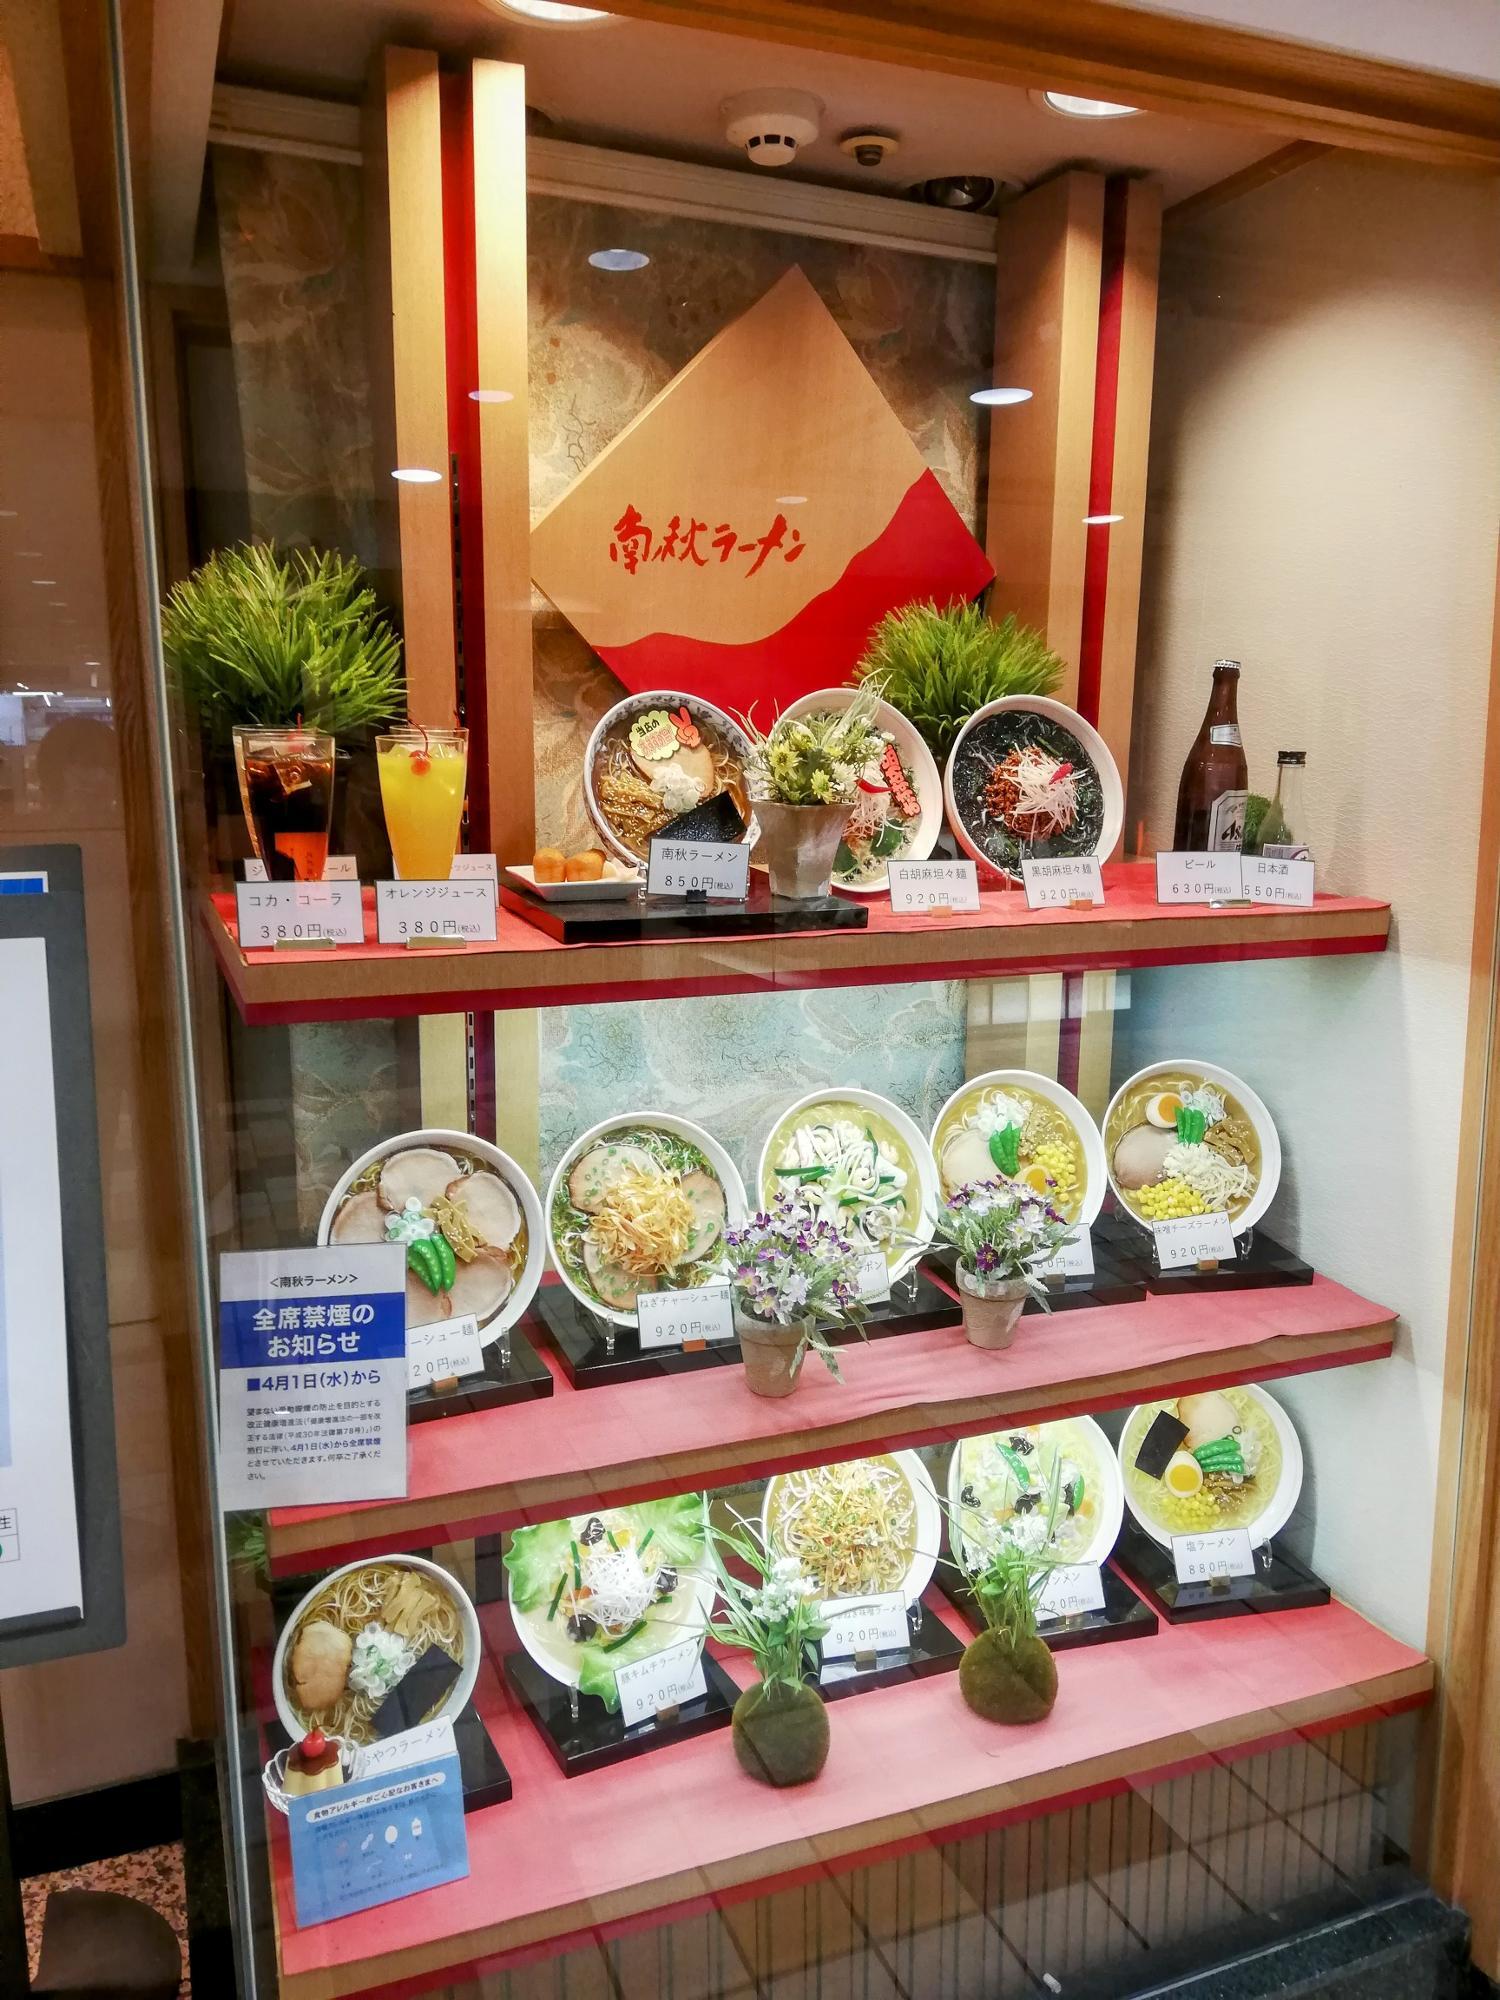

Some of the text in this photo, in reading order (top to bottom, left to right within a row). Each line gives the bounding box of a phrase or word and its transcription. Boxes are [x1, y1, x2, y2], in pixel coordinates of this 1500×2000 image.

[609, 504, 807, 578] 南秋ラーメン
[661, 847, 738, 863] 南秋ラーメン
[1185, 859, 1216, 869] ビール
[1258, 862, 1289, 875] 日本酒
[385, 886, 488, 899] オレンジジュース
[252, 1304, 375, 1331] 全席禁煙の
[267, 1331, 361, 1358] お知らせ
[1186, 1536, 1236, 1552] 塩ラーメン
